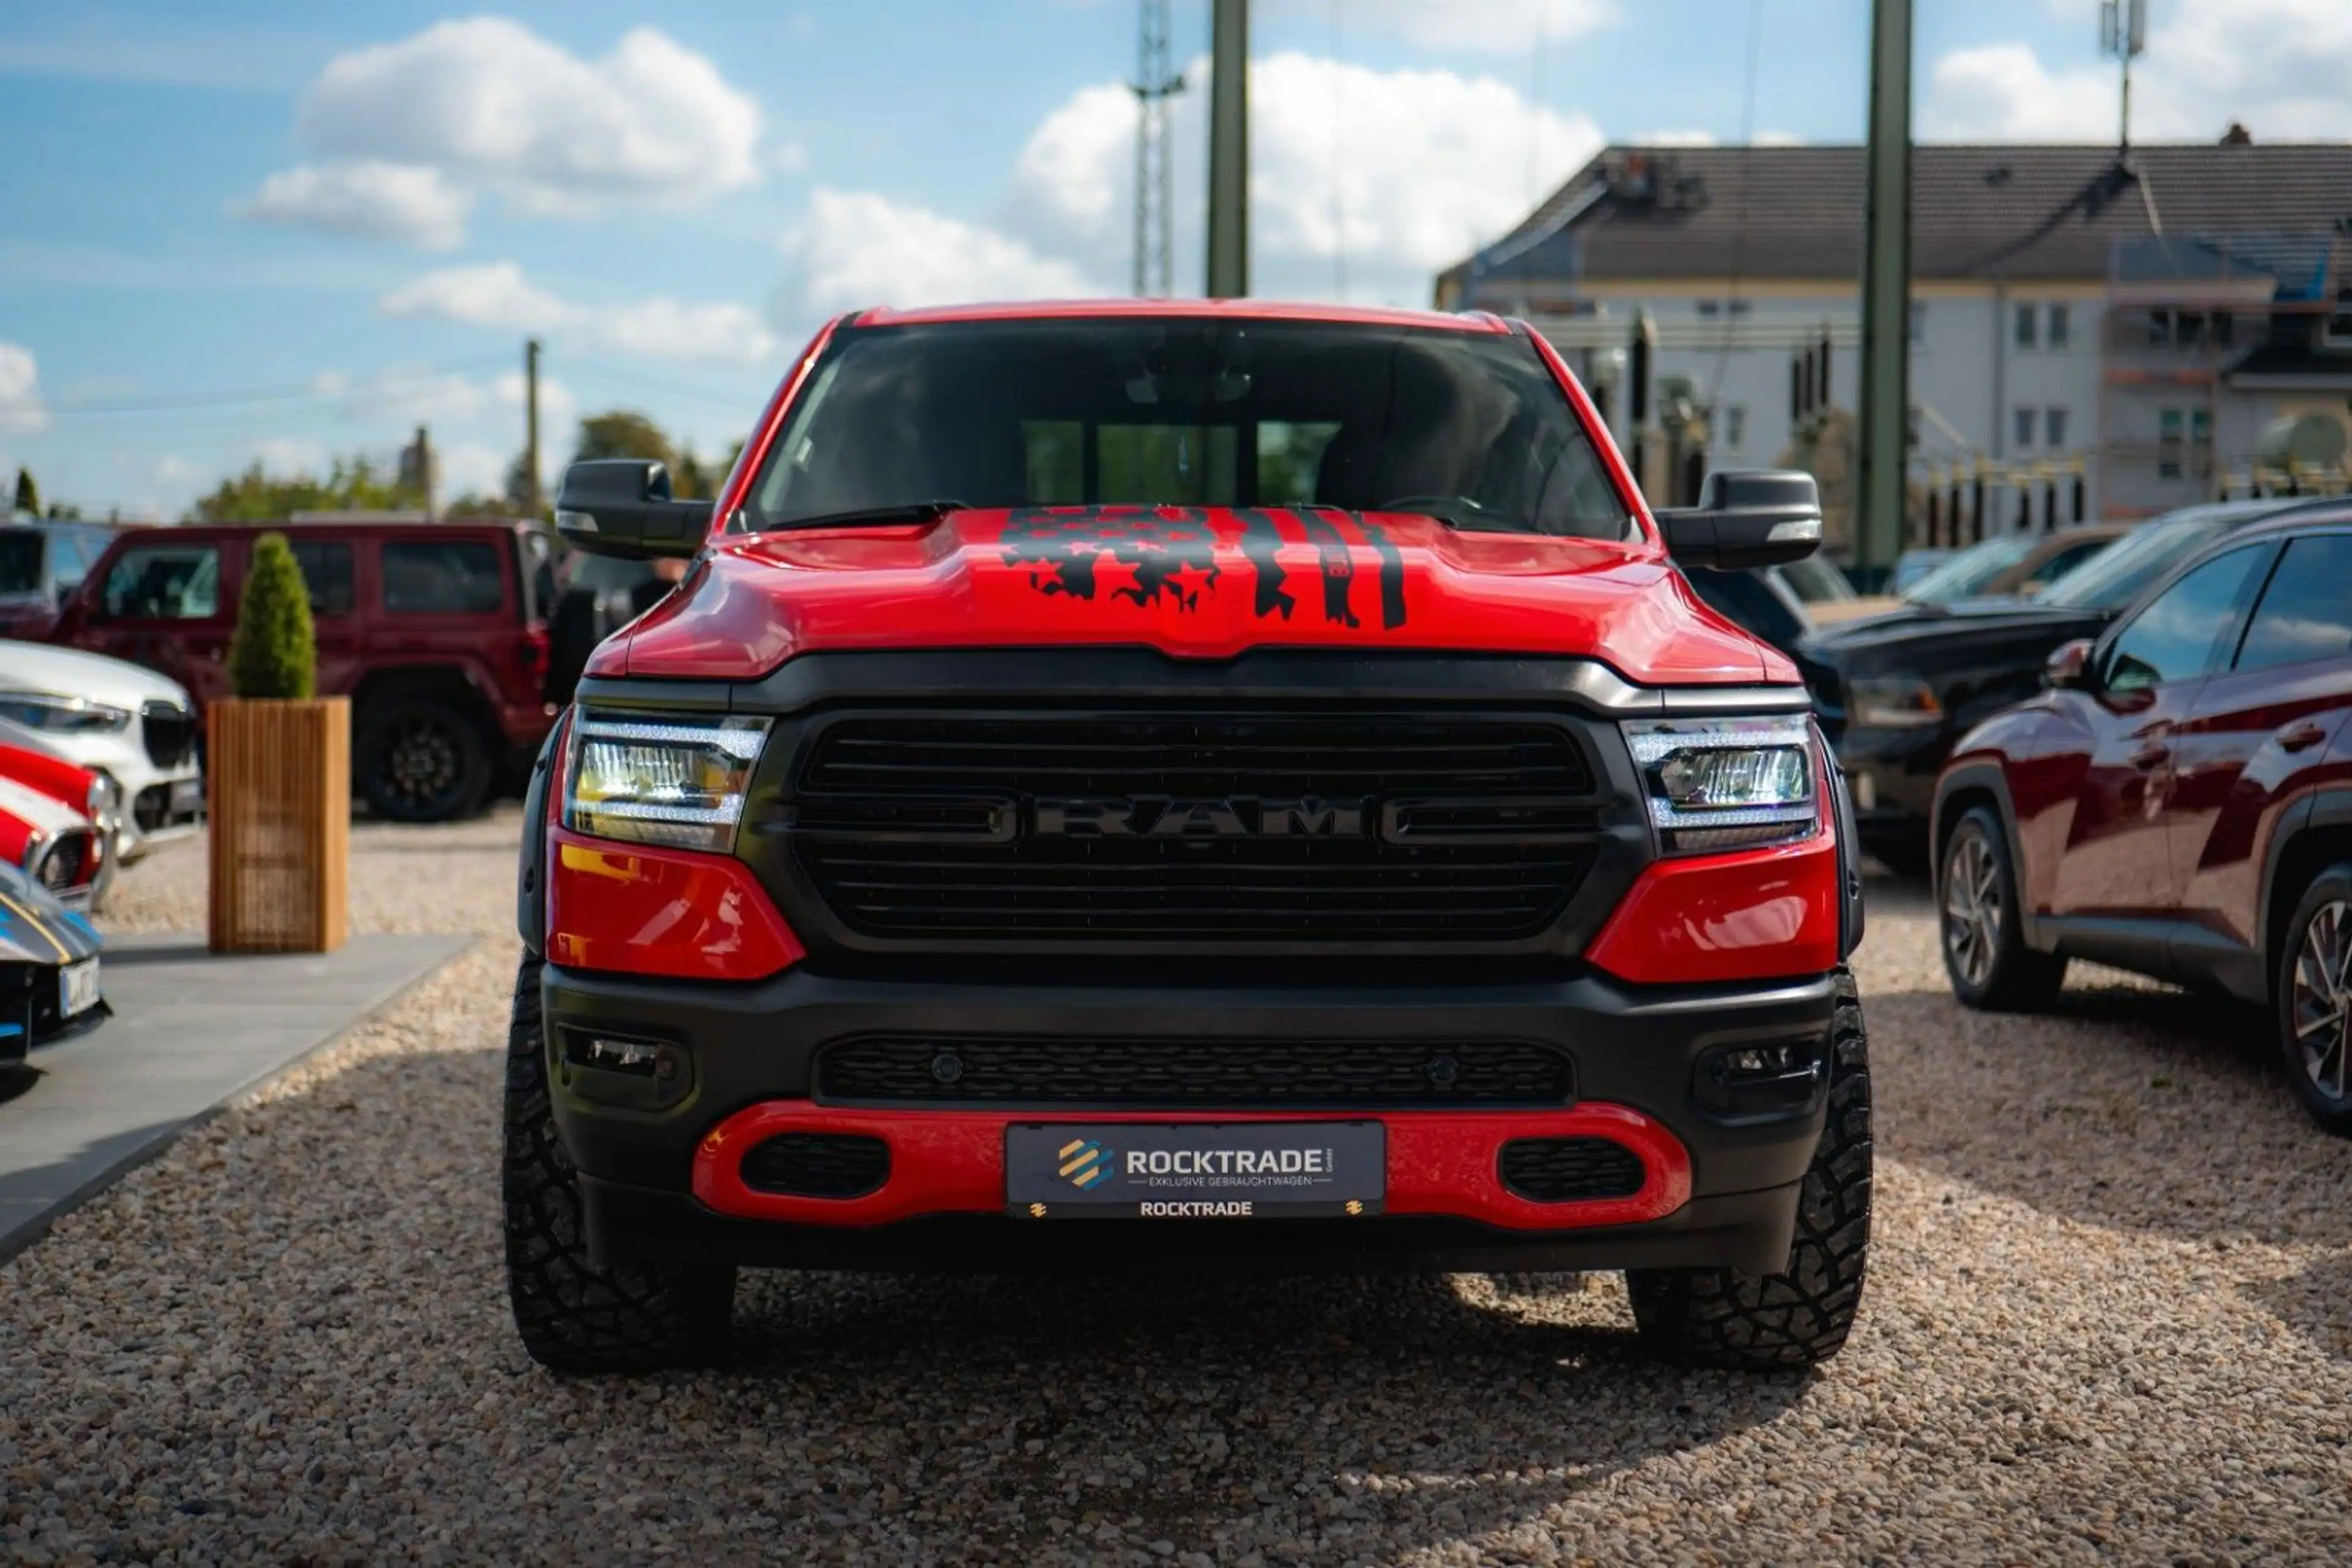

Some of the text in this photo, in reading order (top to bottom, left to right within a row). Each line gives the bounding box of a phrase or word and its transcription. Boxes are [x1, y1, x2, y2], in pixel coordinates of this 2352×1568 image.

[1035, 795, 1362, 839] RAM
[1127, 1150, 1322, 1174] ROCKTRADE
[1149, 1175, 1312, 1187] EXKLUSIVE GEBRAUCHTWAGEN
[1140, 1201, 1253, 1216] ROCKTRADE
